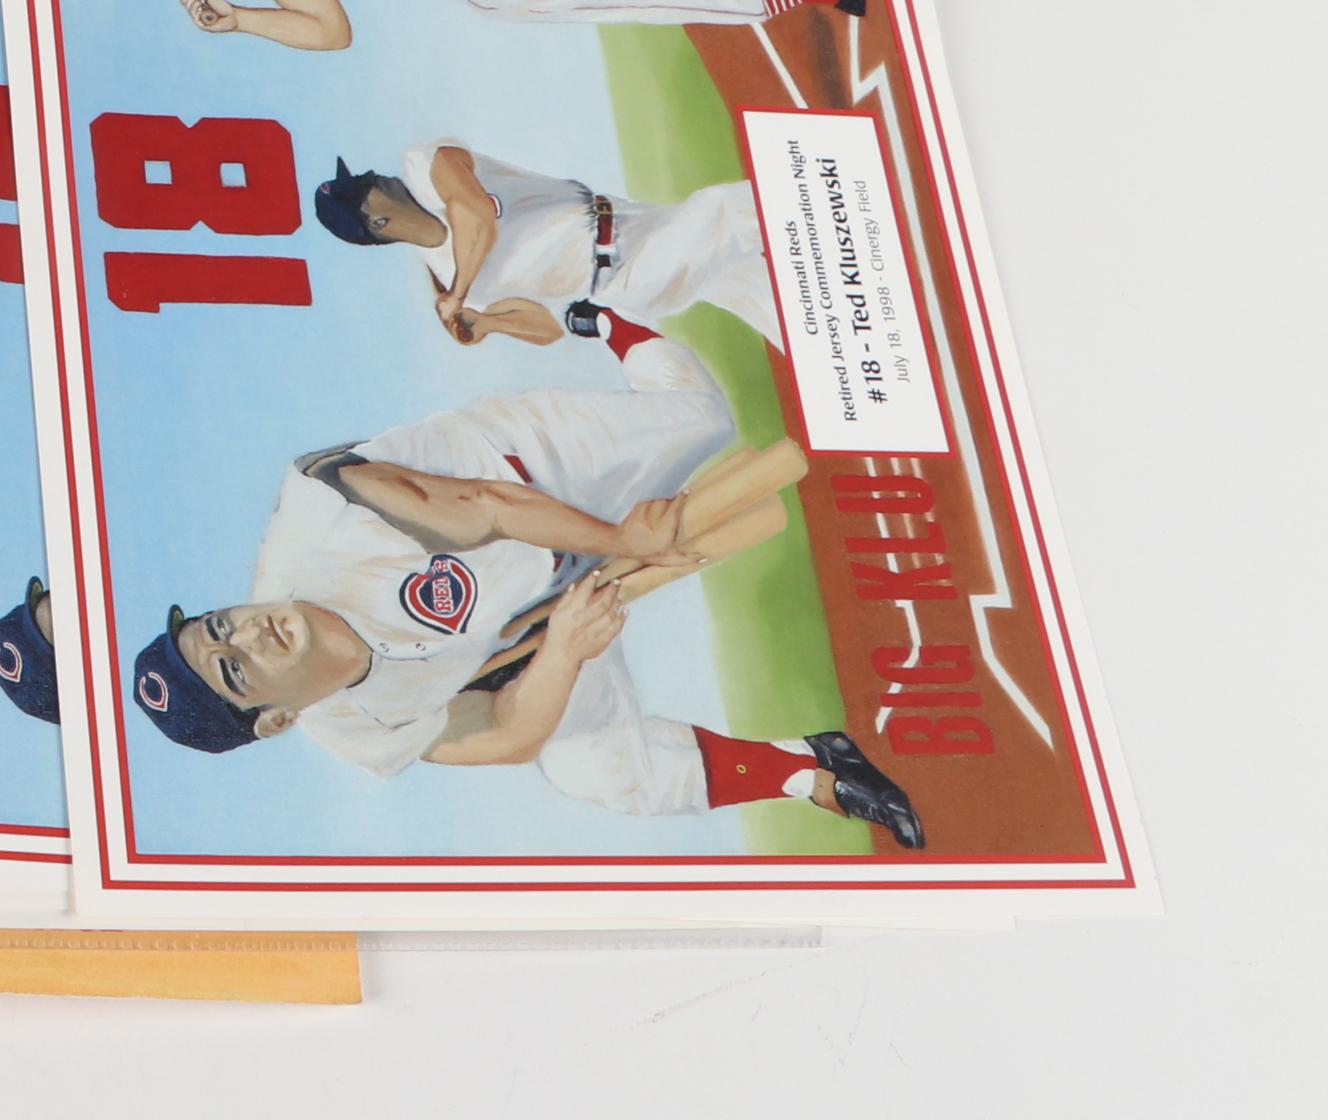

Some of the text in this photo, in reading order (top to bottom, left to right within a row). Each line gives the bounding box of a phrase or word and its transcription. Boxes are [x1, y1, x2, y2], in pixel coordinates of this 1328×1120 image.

[89, 112, 313, 313] 18
[785, 220, 818, 335] Cincinnati Reds
[788, 140, 857, 422] Retired Jersey Commemoration Night
[815, 158, 887, 404] #18 Ted Kluszewski
[853, 180, 910, 383] July 18, 1998 Cinergy Field
[830, 475, 996, 755] BIG KLU
